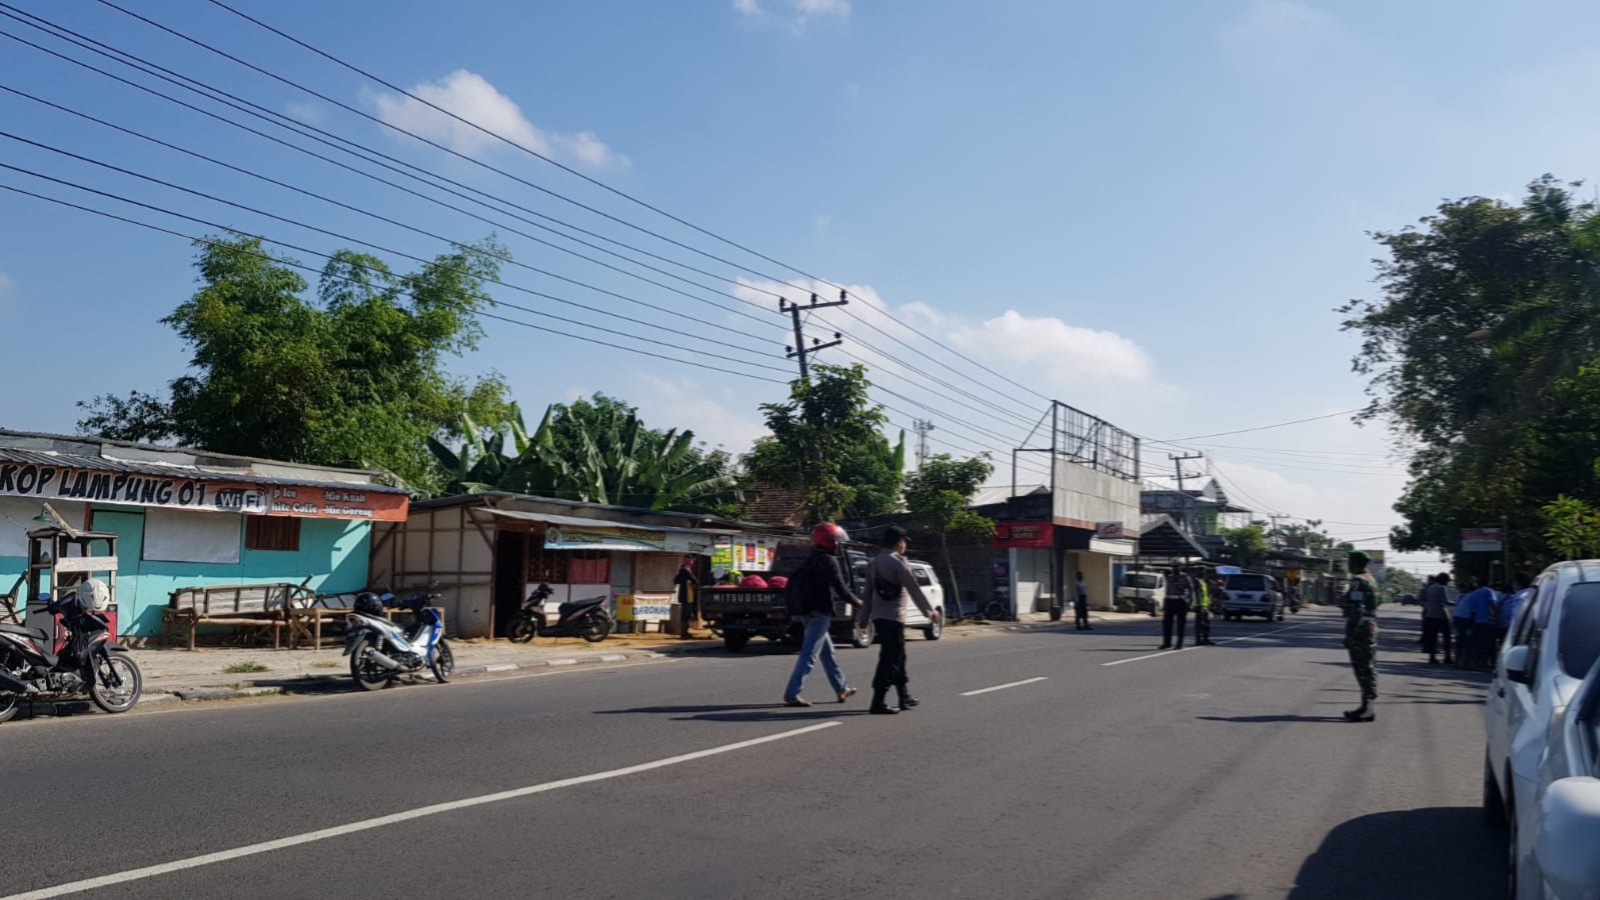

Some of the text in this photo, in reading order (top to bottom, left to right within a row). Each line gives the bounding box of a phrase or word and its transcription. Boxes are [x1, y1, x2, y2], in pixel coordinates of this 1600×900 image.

[58, 469, 173, 505] LAMPUNG
[283, 488, 297, 498] Ice
[342, 506, 374, 518] Goreng
